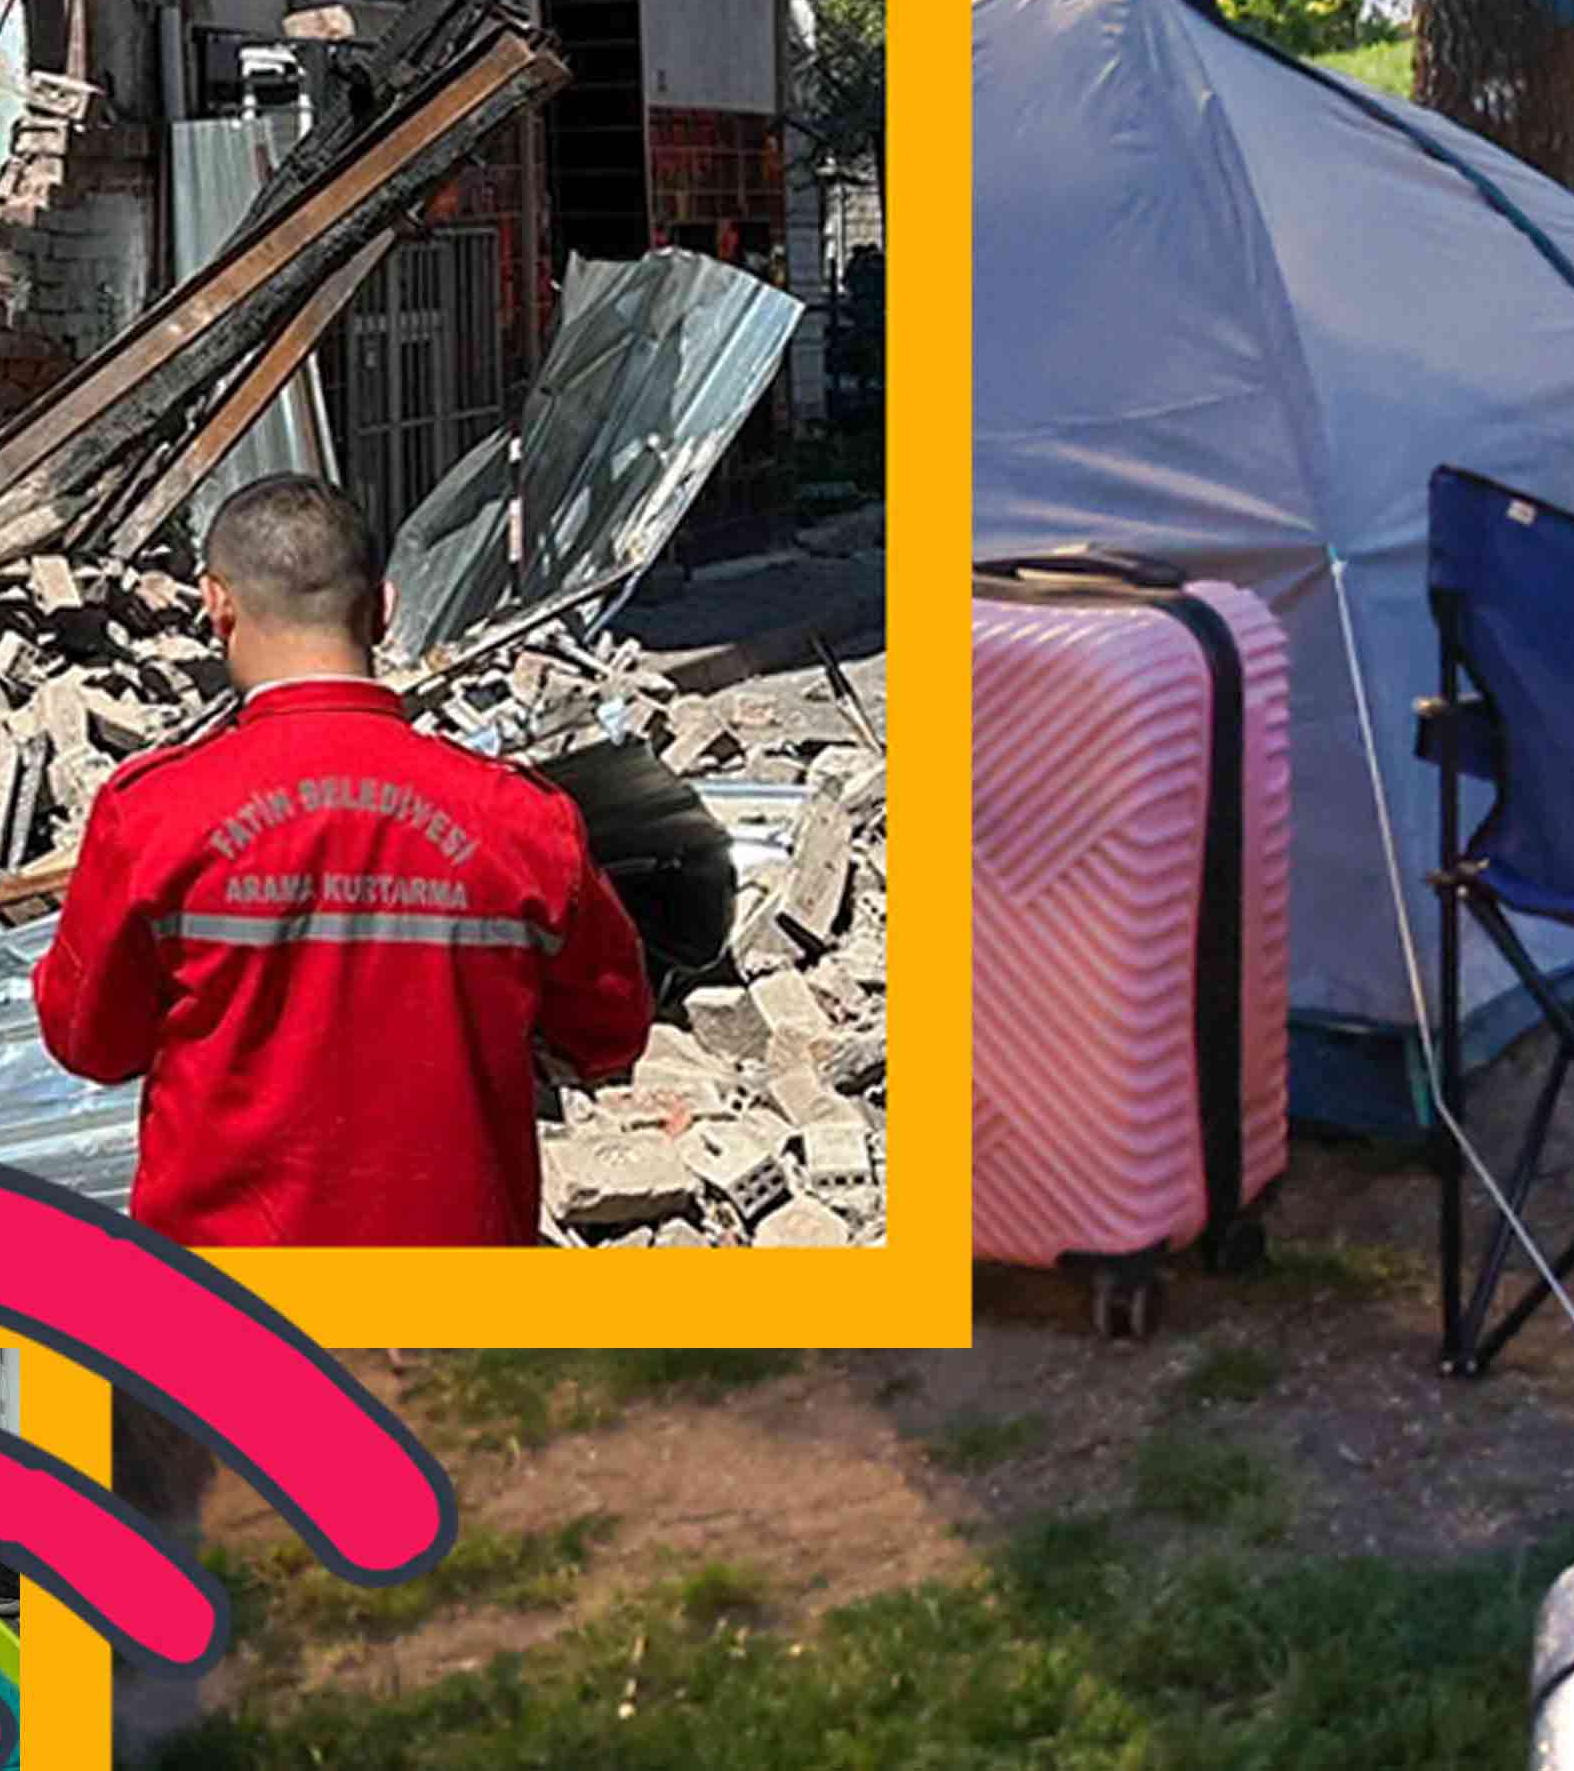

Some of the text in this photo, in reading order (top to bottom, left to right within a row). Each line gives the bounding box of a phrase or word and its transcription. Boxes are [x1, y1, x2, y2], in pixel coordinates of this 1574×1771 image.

[208, 775, 482, 866] FATİH BELEDİYESİ
[225, 872, 468, 909] ARAMA KURTARMA
